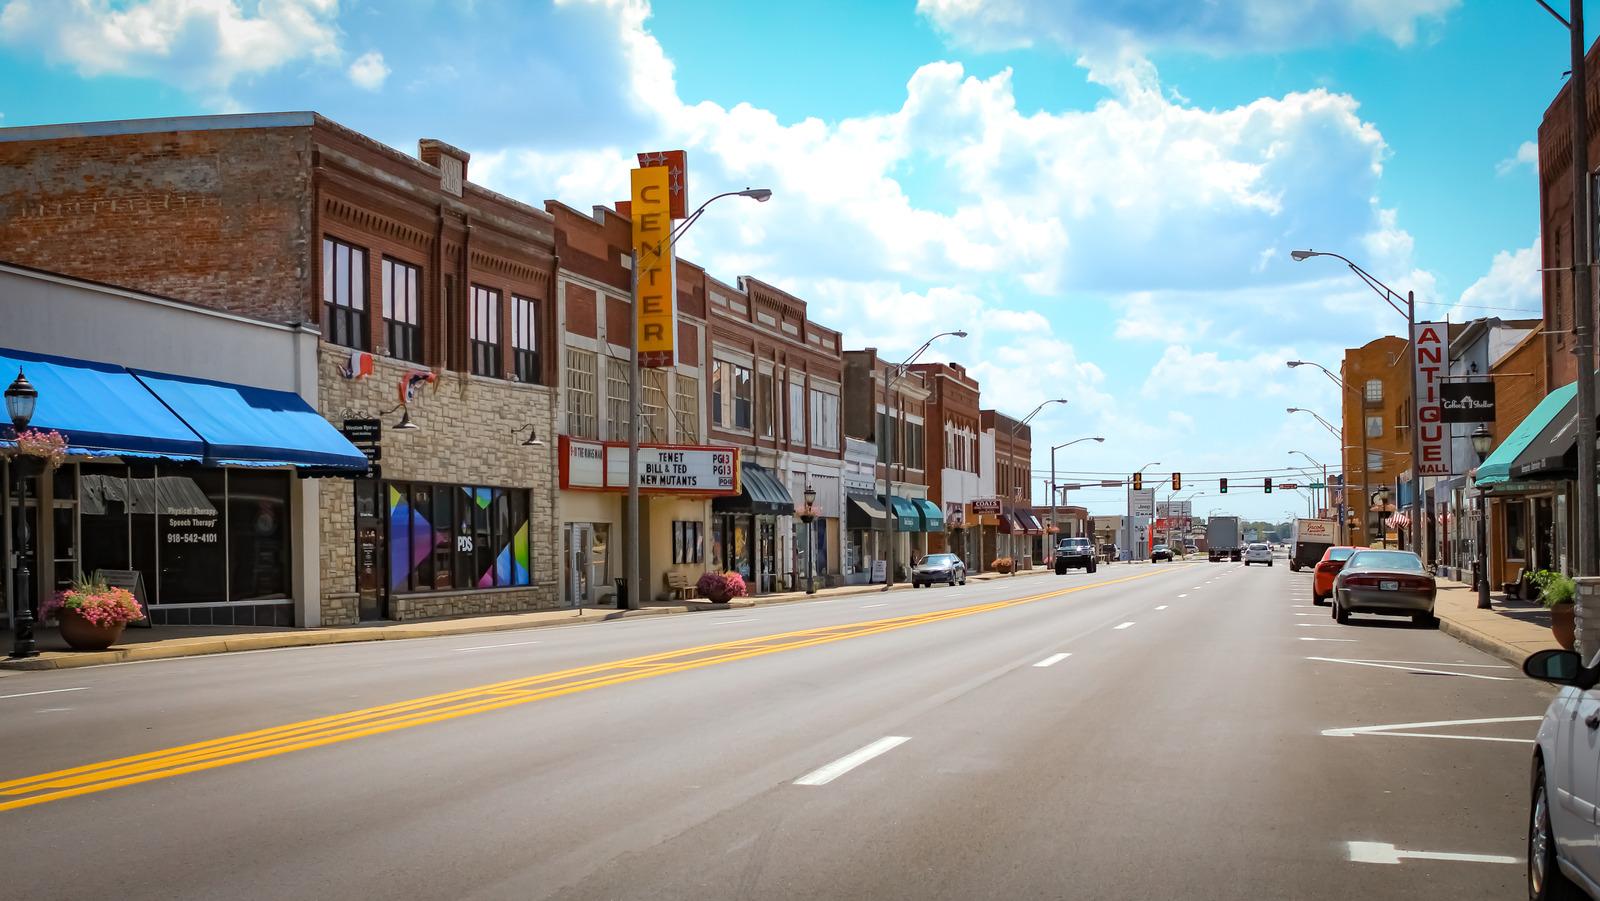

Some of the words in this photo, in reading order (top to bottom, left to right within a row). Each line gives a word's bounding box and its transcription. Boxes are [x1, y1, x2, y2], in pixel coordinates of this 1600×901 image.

[640, 186, 664, 341] CENTER
[1417, 328, 1442, 461] ANTIQUE
[1444, 400, 1461, 408] Coffee
[659, 453, 684, 462] TENET
[713, 454, 730, 464] PG13
[646, 464, 663, 473] BILL
[673, 464, 687, 474] TED
[713, 466, 731, 475] PG13
[1418, 464, 1449, 473] MALL
[640, 475, 657, 485] NEW
[660, 476, 697, 486] MUTANTS
[168, 507, 192, 516] Physical
[193, 507, 216, 516] Therapy
[169, 518, 191, 527] Speech
[192, 518, 215, 527] Therapy
[167, 533, 217, 543] 918-542-4101
[457, 535, 473, 551] PDS
